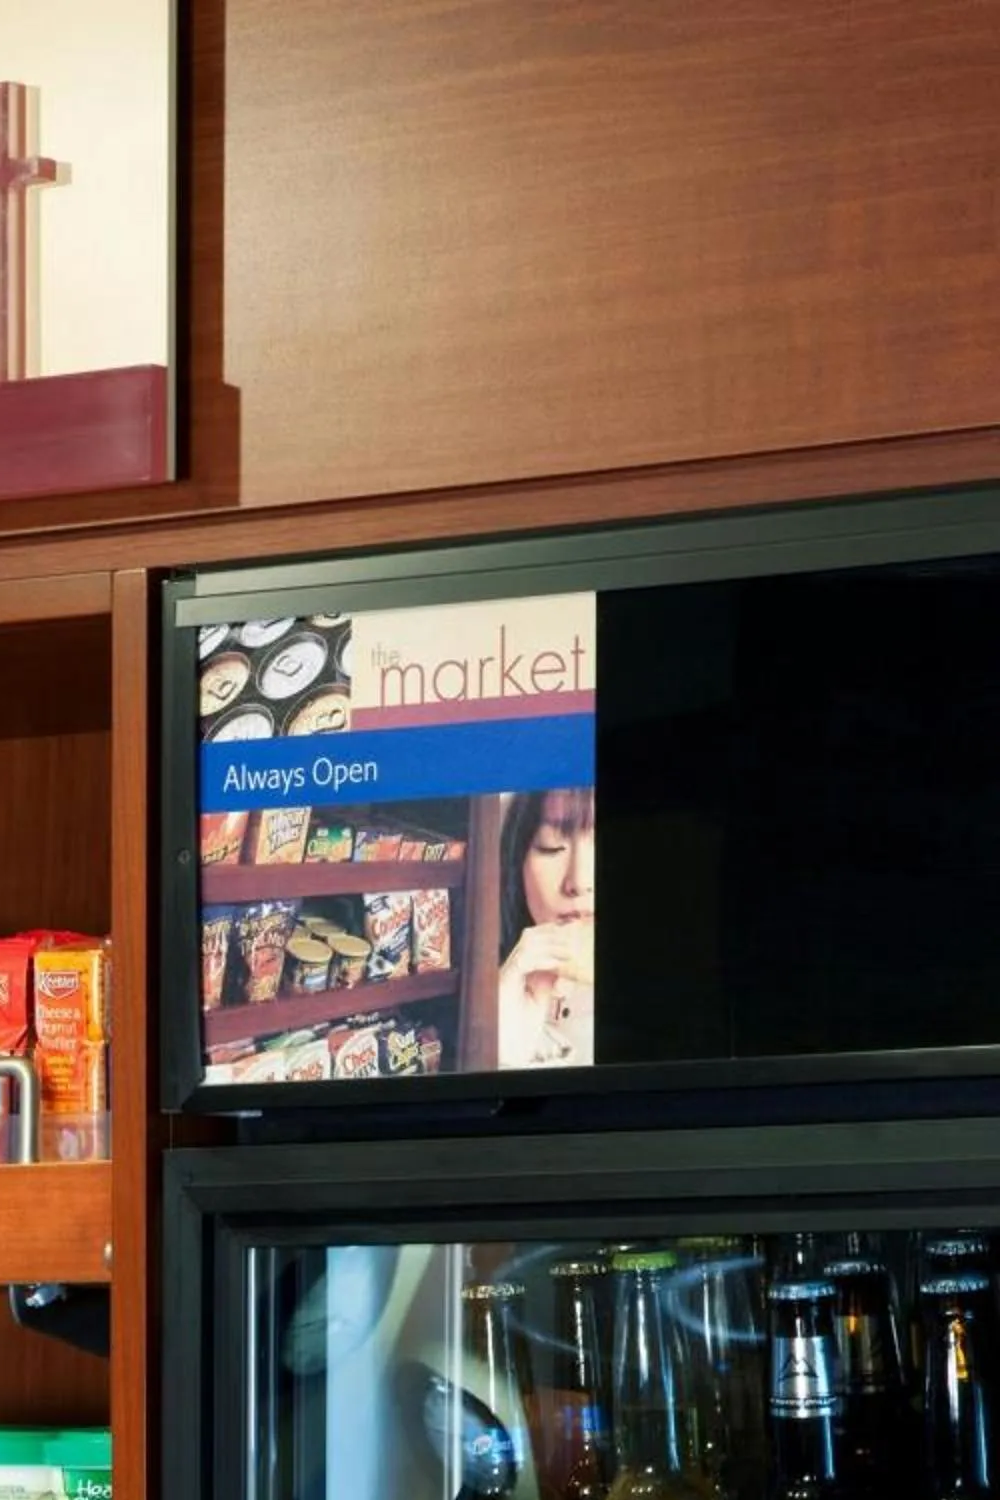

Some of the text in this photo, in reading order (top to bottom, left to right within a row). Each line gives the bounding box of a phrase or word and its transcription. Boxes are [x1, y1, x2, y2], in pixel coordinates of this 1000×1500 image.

[371, 643, 399, 669] the
[380, 625, 586, 709] market
[223, 757, 378, 795] Always Open
